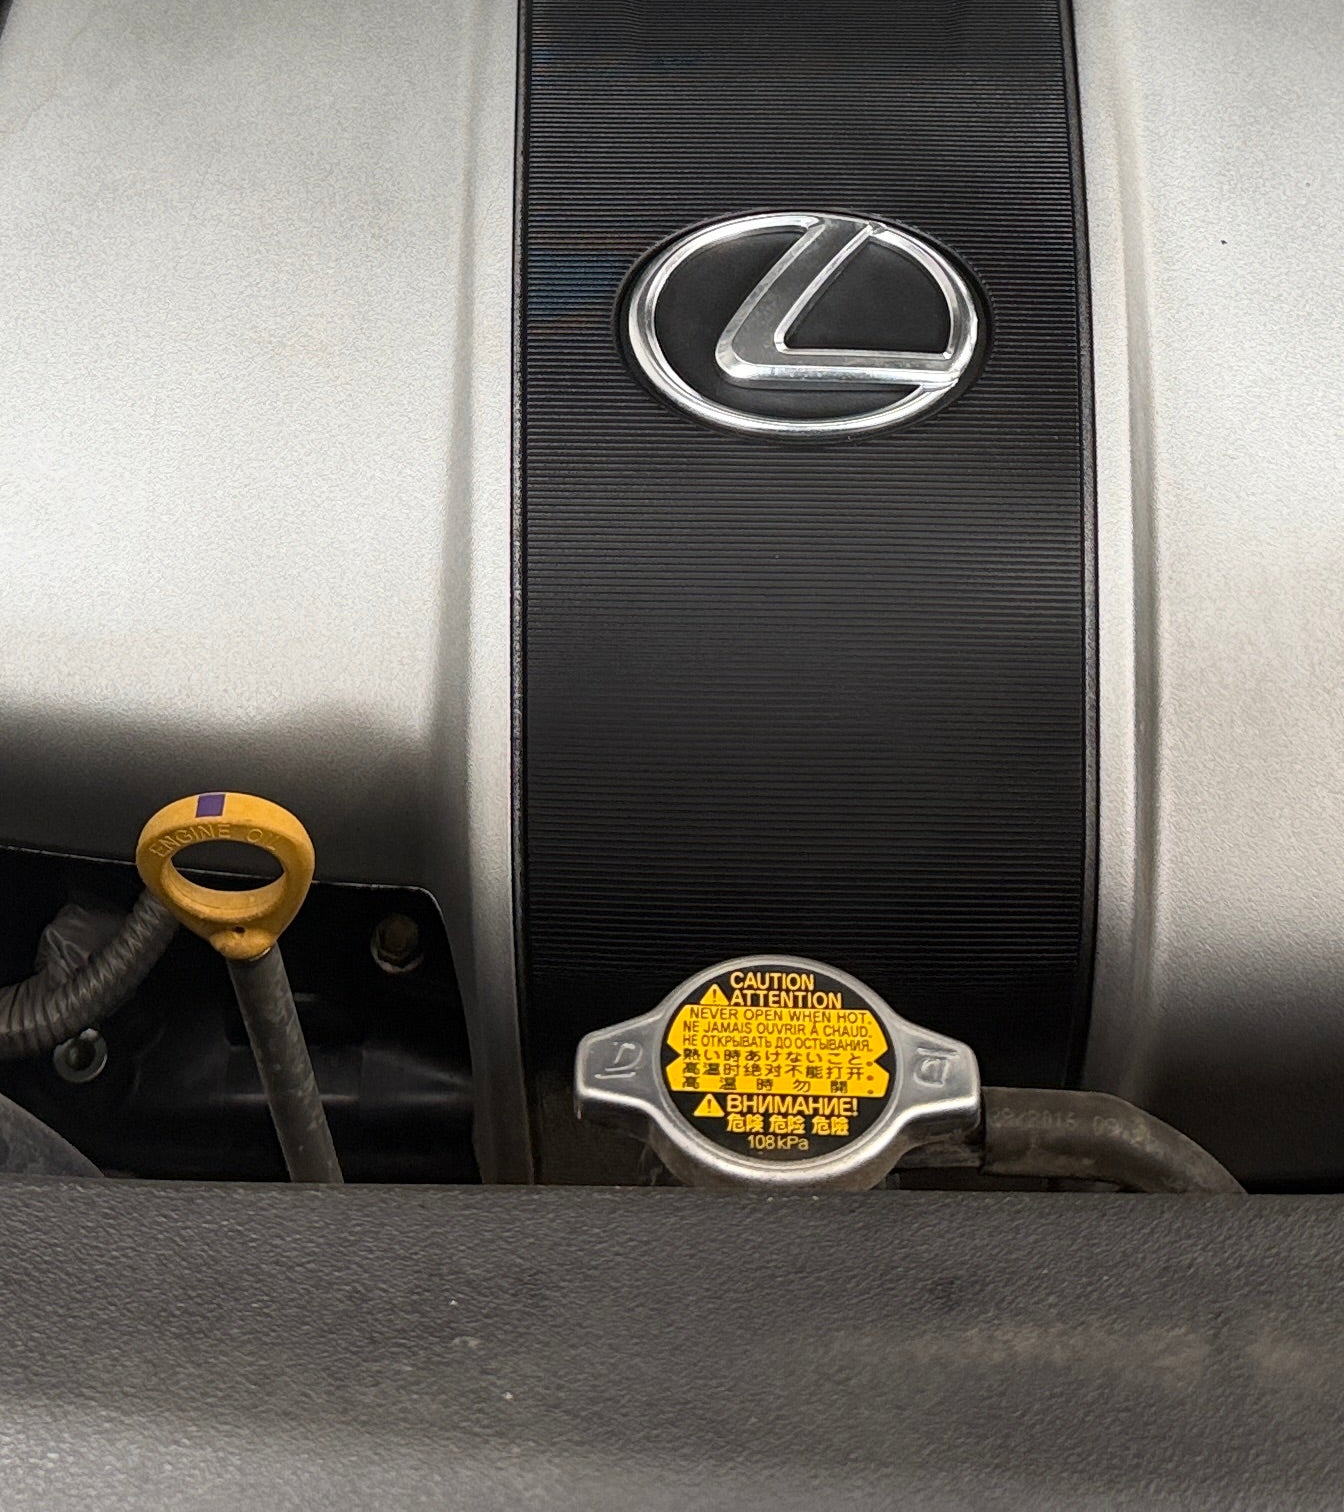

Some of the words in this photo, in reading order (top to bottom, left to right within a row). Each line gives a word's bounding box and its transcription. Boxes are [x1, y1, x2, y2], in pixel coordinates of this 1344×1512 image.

[148, 823, 231, 858] ENGINE
[730, 971, 815, 991] CAUTION
[730, 989, 842, 1010] ATTENTION
[689, 1007, 739, 1020] NEVER
[743, 1008, 783, 1022] OPEN
[788, 1010, 832, 1023] WHEN
[682, 1020, 700, 1033] NE
[703, 1021, 753, 1034] JAMAIS
[756, 1022, 806, 1036] OUVRIR
[823, 1024, 873, 1039] CHAUD.
[682, 1033, 698, 1046] НЕ
[701, 1034, 773, 1048] ОТКРЫВАТЬ
[774, 1036, 792, 1050] ДО
[727, 1094, 858, 1117] ВНИМАНИЕ!
